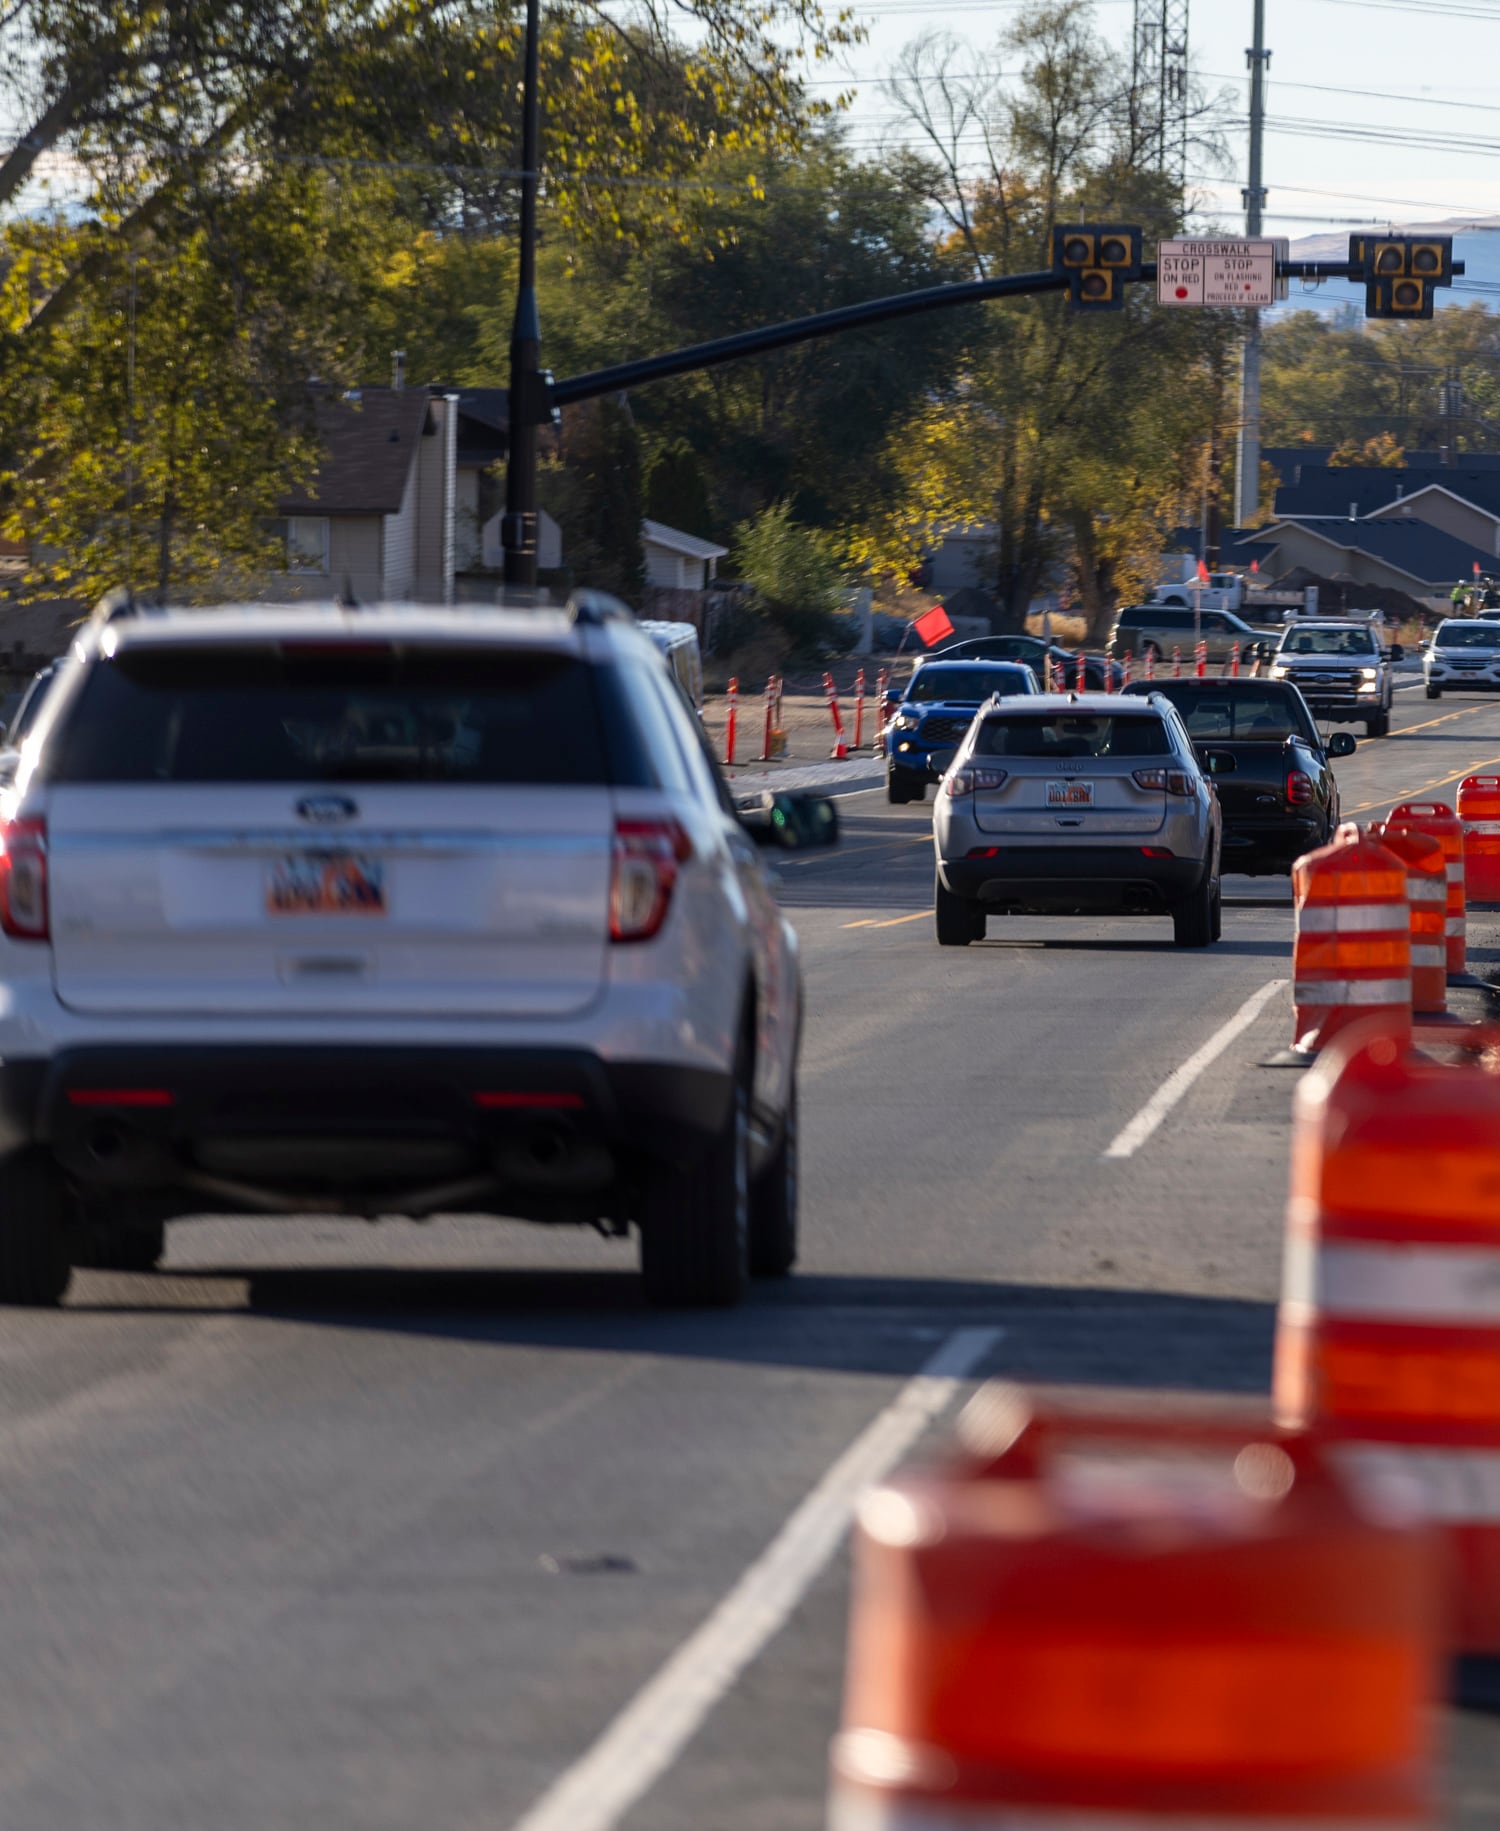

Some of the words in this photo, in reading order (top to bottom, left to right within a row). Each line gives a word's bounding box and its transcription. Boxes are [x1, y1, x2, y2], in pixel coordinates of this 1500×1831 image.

[1182, 243, 1250, 256] CROSSWALK
[1163, 257, 1200, 272] STOP
[1224, 259, 1253, 270] STOP
[1163, 272, 1178, 284] ON
[1182, 273, 1200, 284] RED
[1214, 272, 1225, 282] ON
[1226, 272, 1263, 282] FLASHING
[1224, 282, 1239, 292] RED
[1206, 292, 1237, 302] PROCEED
[1247, 292, 1269, 303] CLEAR
